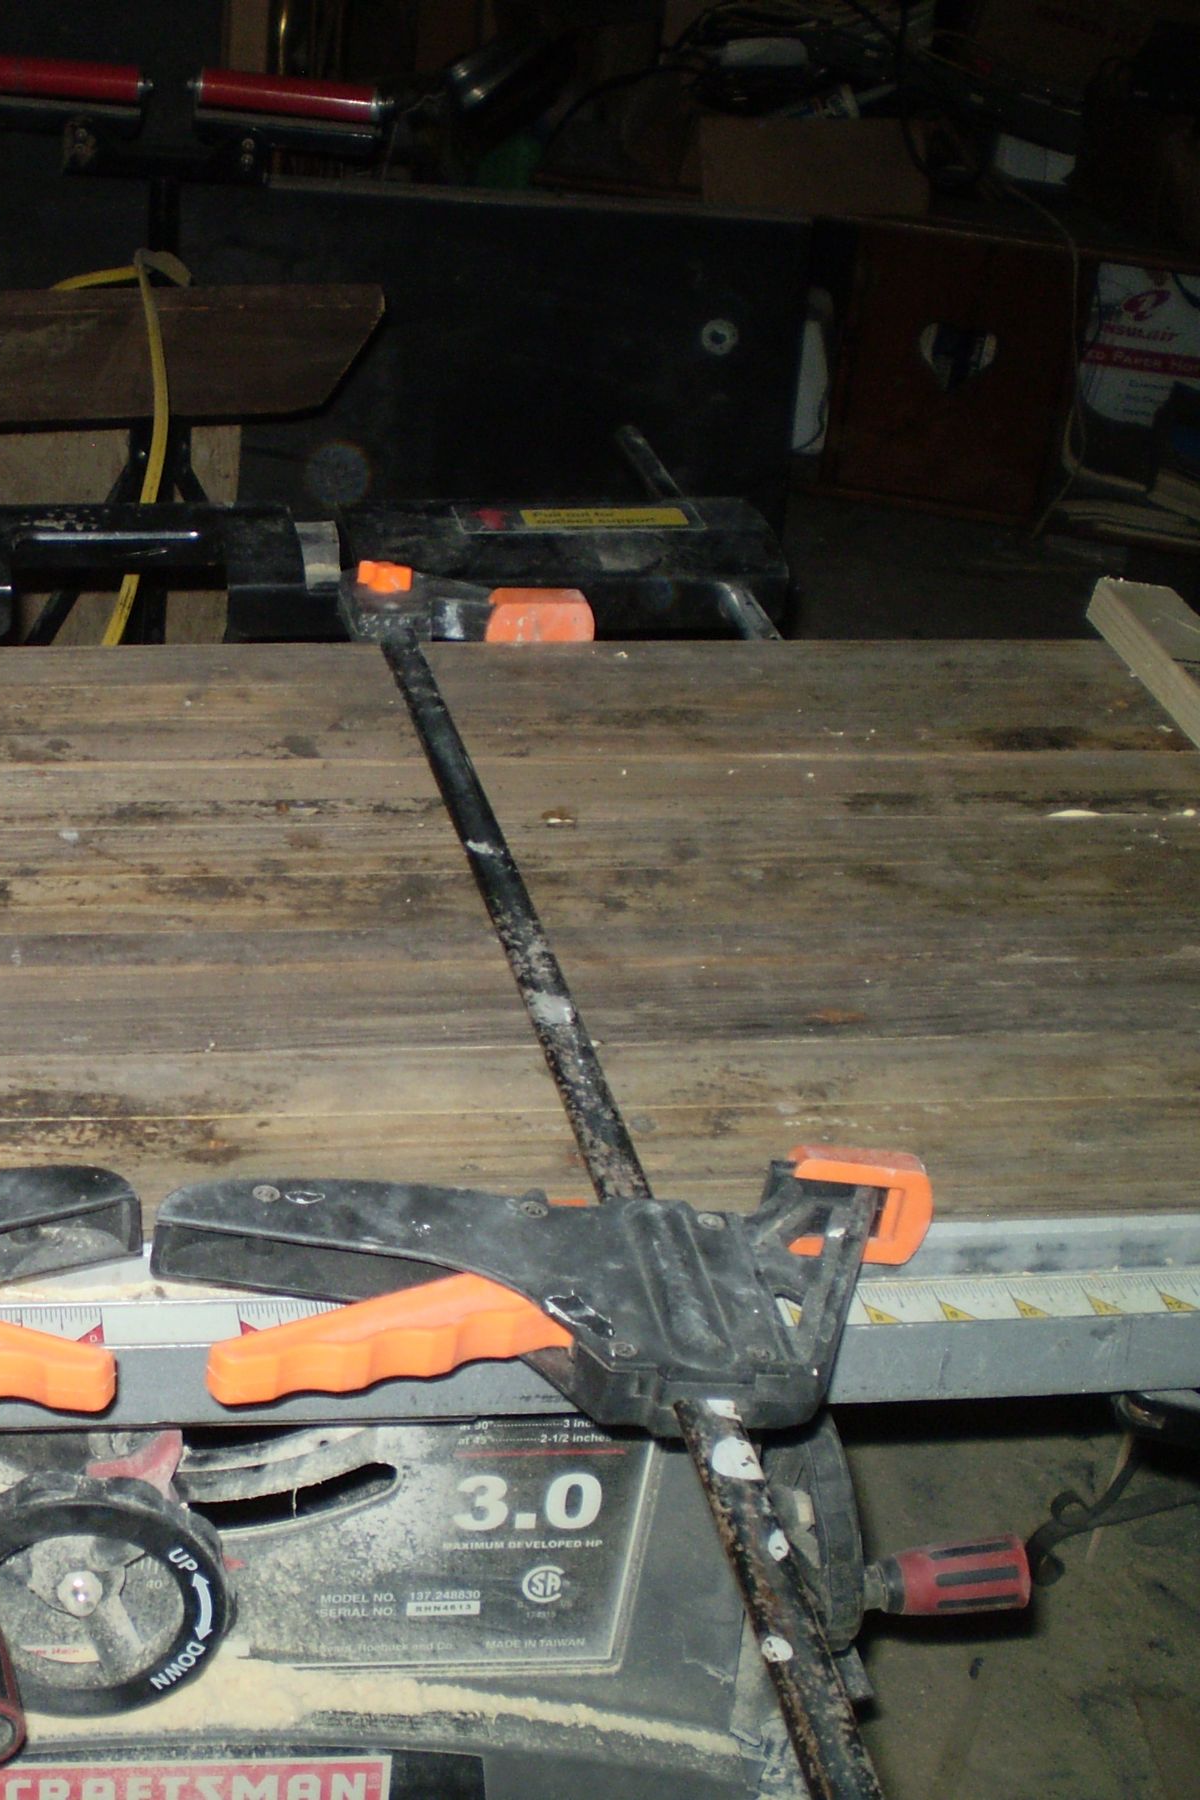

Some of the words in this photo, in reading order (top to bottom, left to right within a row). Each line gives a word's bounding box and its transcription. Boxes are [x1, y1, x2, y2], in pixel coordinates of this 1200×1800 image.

[563, 1418, 571, 1429] 3
[540, 1433, 569, 1444] 2-1/2
[453, 1472, 603, 1532] 3.0
[443, 1540, 505, 1551] MAXIMUM
[508, 1539, 583, 1550] DEVELOPED
[586, 1539, 604, 1549] HP
[168, 1547, 199, 1573] UP
[320, 1593, 369, 1605] MODEL
[373, 1592, 396, 1603] NO.
[319, 1607, 369, 1619] SERIAL
[486, 1638, 521, 1650] MADE
[524, 1638, 537, 1649] IN
[539, 1636, 586, 1648] TAIWAN
[150, 1641, 206, 1690] DOWN
[4, 1772, 367, 1800] CRAFTSMAN
